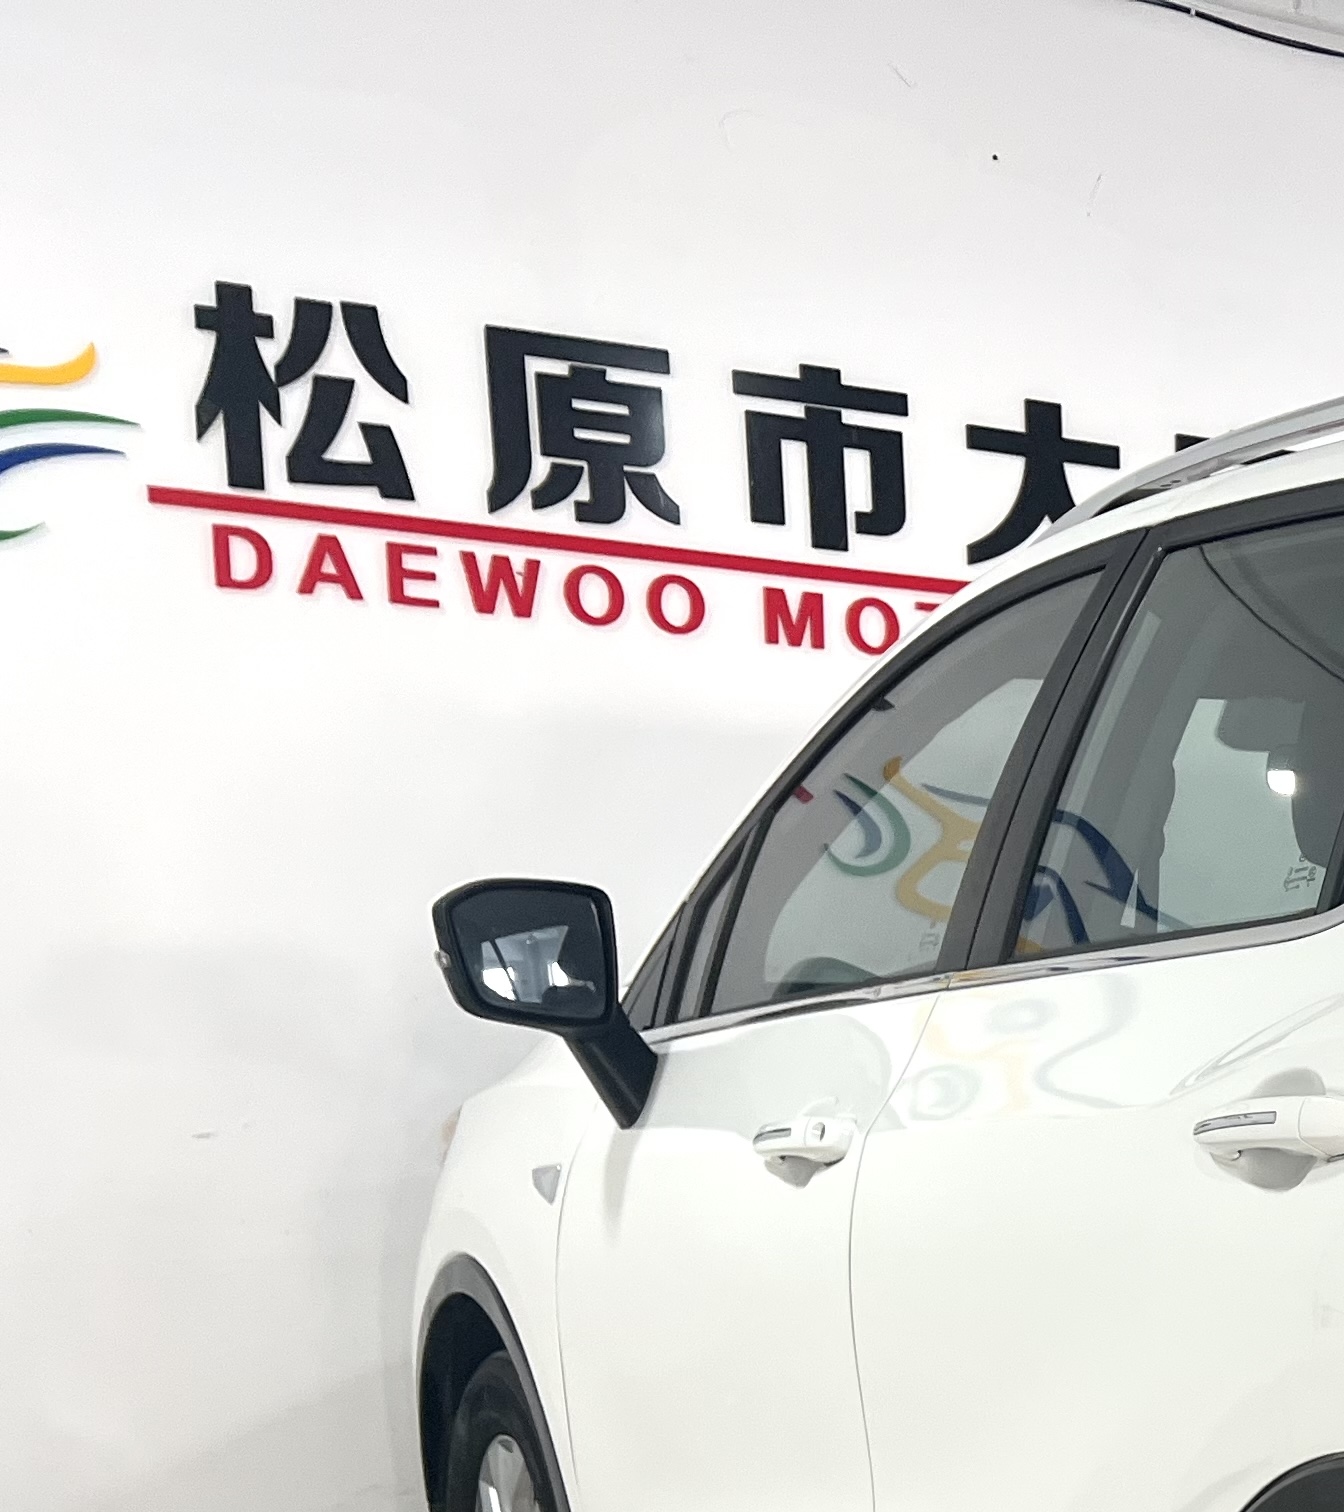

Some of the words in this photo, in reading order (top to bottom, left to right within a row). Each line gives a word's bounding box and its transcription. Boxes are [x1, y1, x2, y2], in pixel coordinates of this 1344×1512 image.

[194, 280, 1210, 563] 松原市大
[210, 522, 706, 636] DAEWOO
